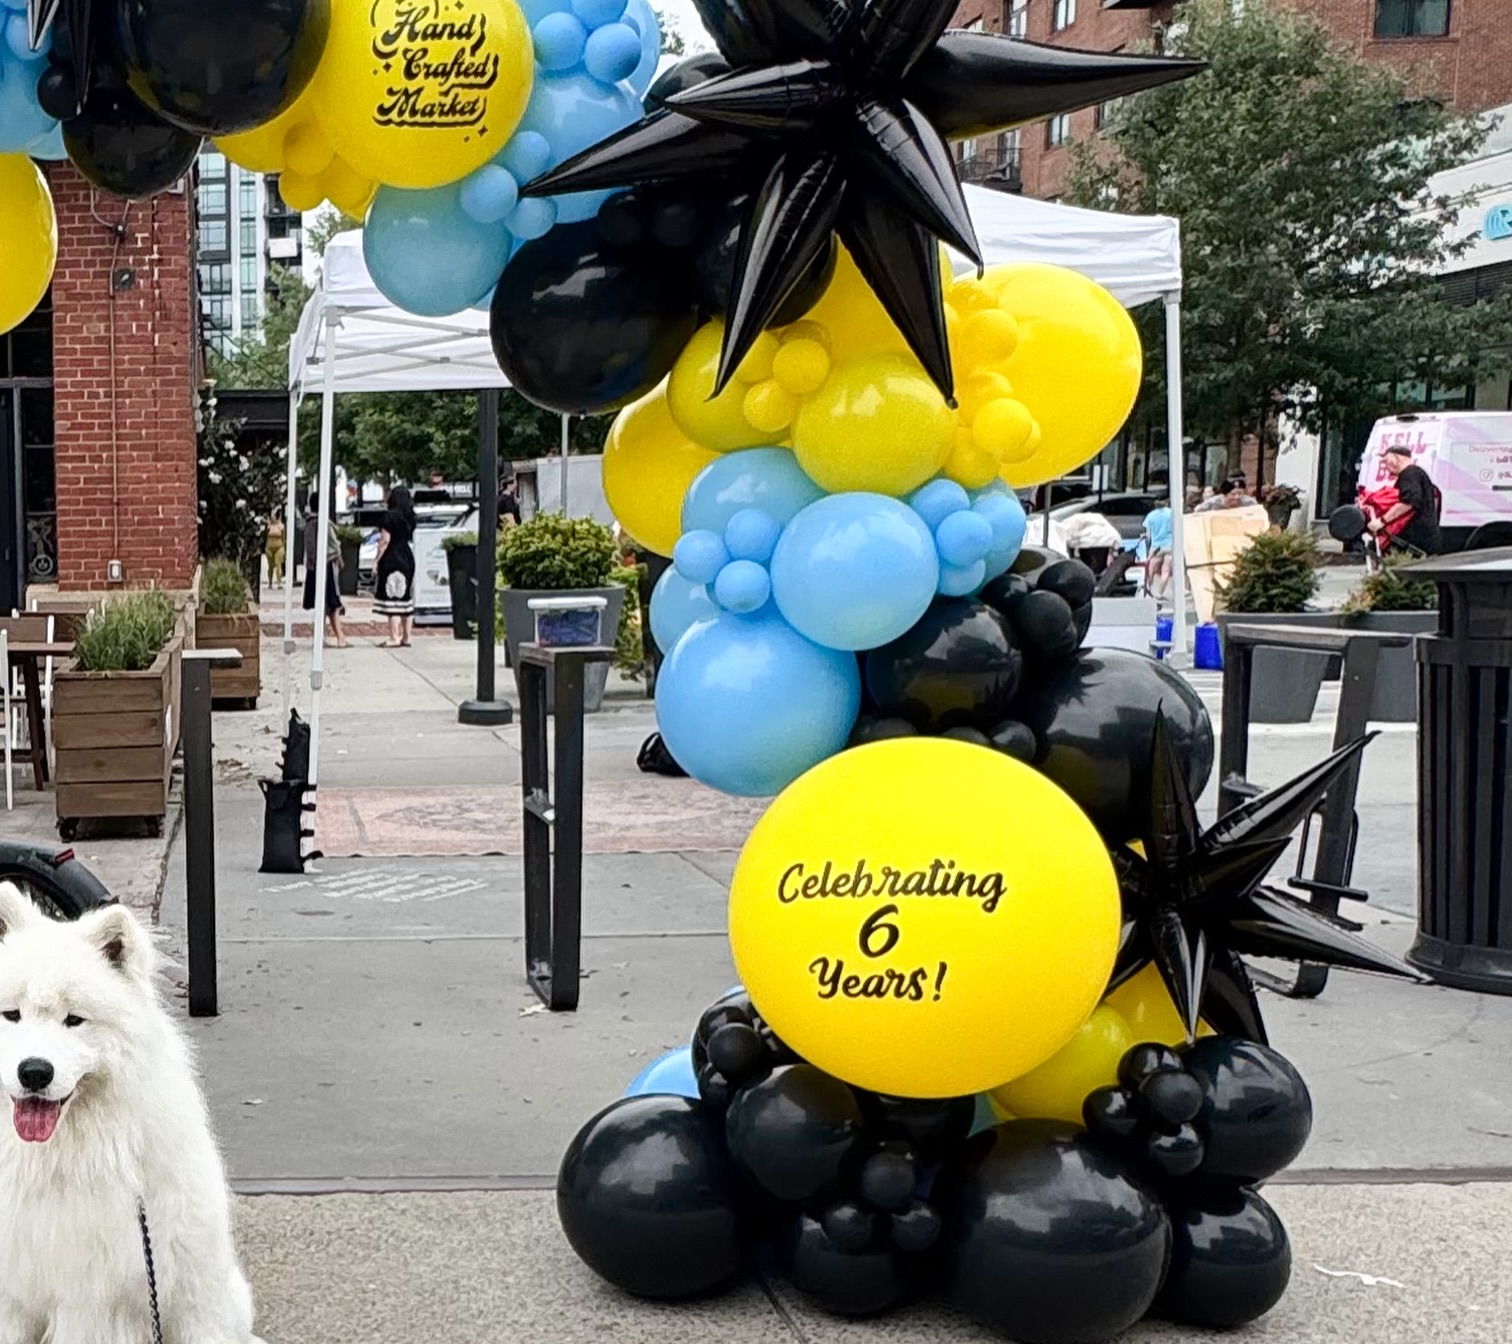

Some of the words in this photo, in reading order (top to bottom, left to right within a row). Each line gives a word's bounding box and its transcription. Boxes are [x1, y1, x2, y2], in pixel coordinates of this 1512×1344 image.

[381, 6, 476, 45] Hand
[402, 47, 490, 87] Crafted
[376, 86, 480, 119] Market
[777, 858, 1007, 913] Celebrating
[858, 903, 900, 958] 6
[808, 956, 948, 1002] Years!
